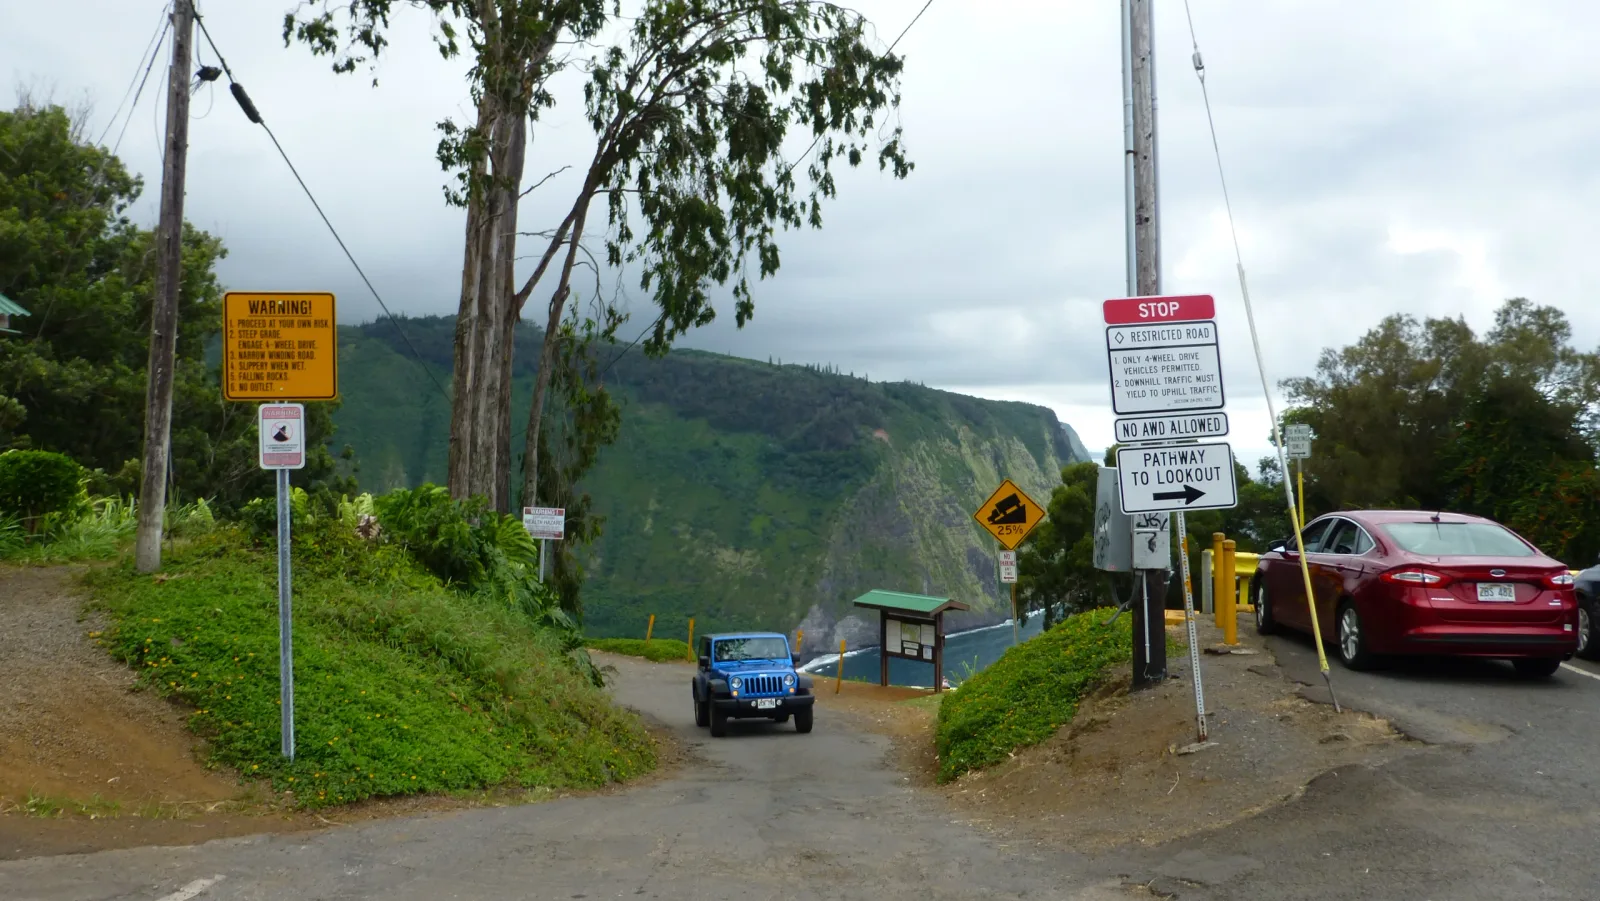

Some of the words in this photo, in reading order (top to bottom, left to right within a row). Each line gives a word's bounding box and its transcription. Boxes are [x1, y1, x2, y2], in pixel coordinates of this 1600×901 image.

[249, 300, 312, 315] WARNING!
[1139, 302, 1179, 317] STOP
[238, 319, 266, 328] PROCEED
[269, 320, 276, 328] AT
[278, 320, 294, 328] YOUR
[297, 320, 311, 328] OWN
[314, 320, 330, 328] RISK.
[229, 330, 235, 338] 2.
[238, 330, 257, 338] STEEP
[260, 330, 282, 338] GRADE.
[1131, 329, 1182, 342] RESTRICTED
[1187, 328, 1209, 339] ROAD
[238, 340, 262, 349] ENGAGE
[265, 340, 295, 349] 4-WHEEL
[298, 340, 318, 349] DRIVE.
[230, 351, 236, 359] 3.
[238, 351, 265, 359] NARROW
[268, 351, 295, 359] WINDING
[298, 351, 316, 359] ROAD.
[1123, 356, 1140, 364] ONLY
[1145, 354, 1175, 363] 4-WHEEL
[1179, 352, 1199, 361] DRIVE
[230, 362, 235, 370] 4.
[239, 362, 268, 370] SLIPPERY
[271, 362, 288, 370] WHEN
[291, 362, 306, 370] WET.
[1124, 366, 1157, 375] VEHICLES
[1162, 364, 1202, 373] PERMITTED.
[239, 372, 264, 381] FALLING
[267, 372, 289, 381] ROCKS.
[1125, 377, 1160, 387] DOWNHILL
[1164, 376, 1192, 384] TRAFFIC
[1196, 374, 1214, 382] MUST
[239, 383, 247, 391] NO
[250, 383, 275, 391] OUTLET.
[1127, 390, 1146, 398] YIELD
[1162, 387, 1186, 396] UPHILL
[1190, 386, 1219, 394] TRAFFIC.
[1123, 423, 1137, 438] NO
[1143, 421, 1164, 436] AWD
[1171, 418, 1220, 434] ALLOWED
[1144, 450, 1205, 467] PATHWAY
[1132, 472, 1149, 486] TO
[1157, 467, 1220, 484] LOOKOUT
[998, 525, 1023, 535] 25%
